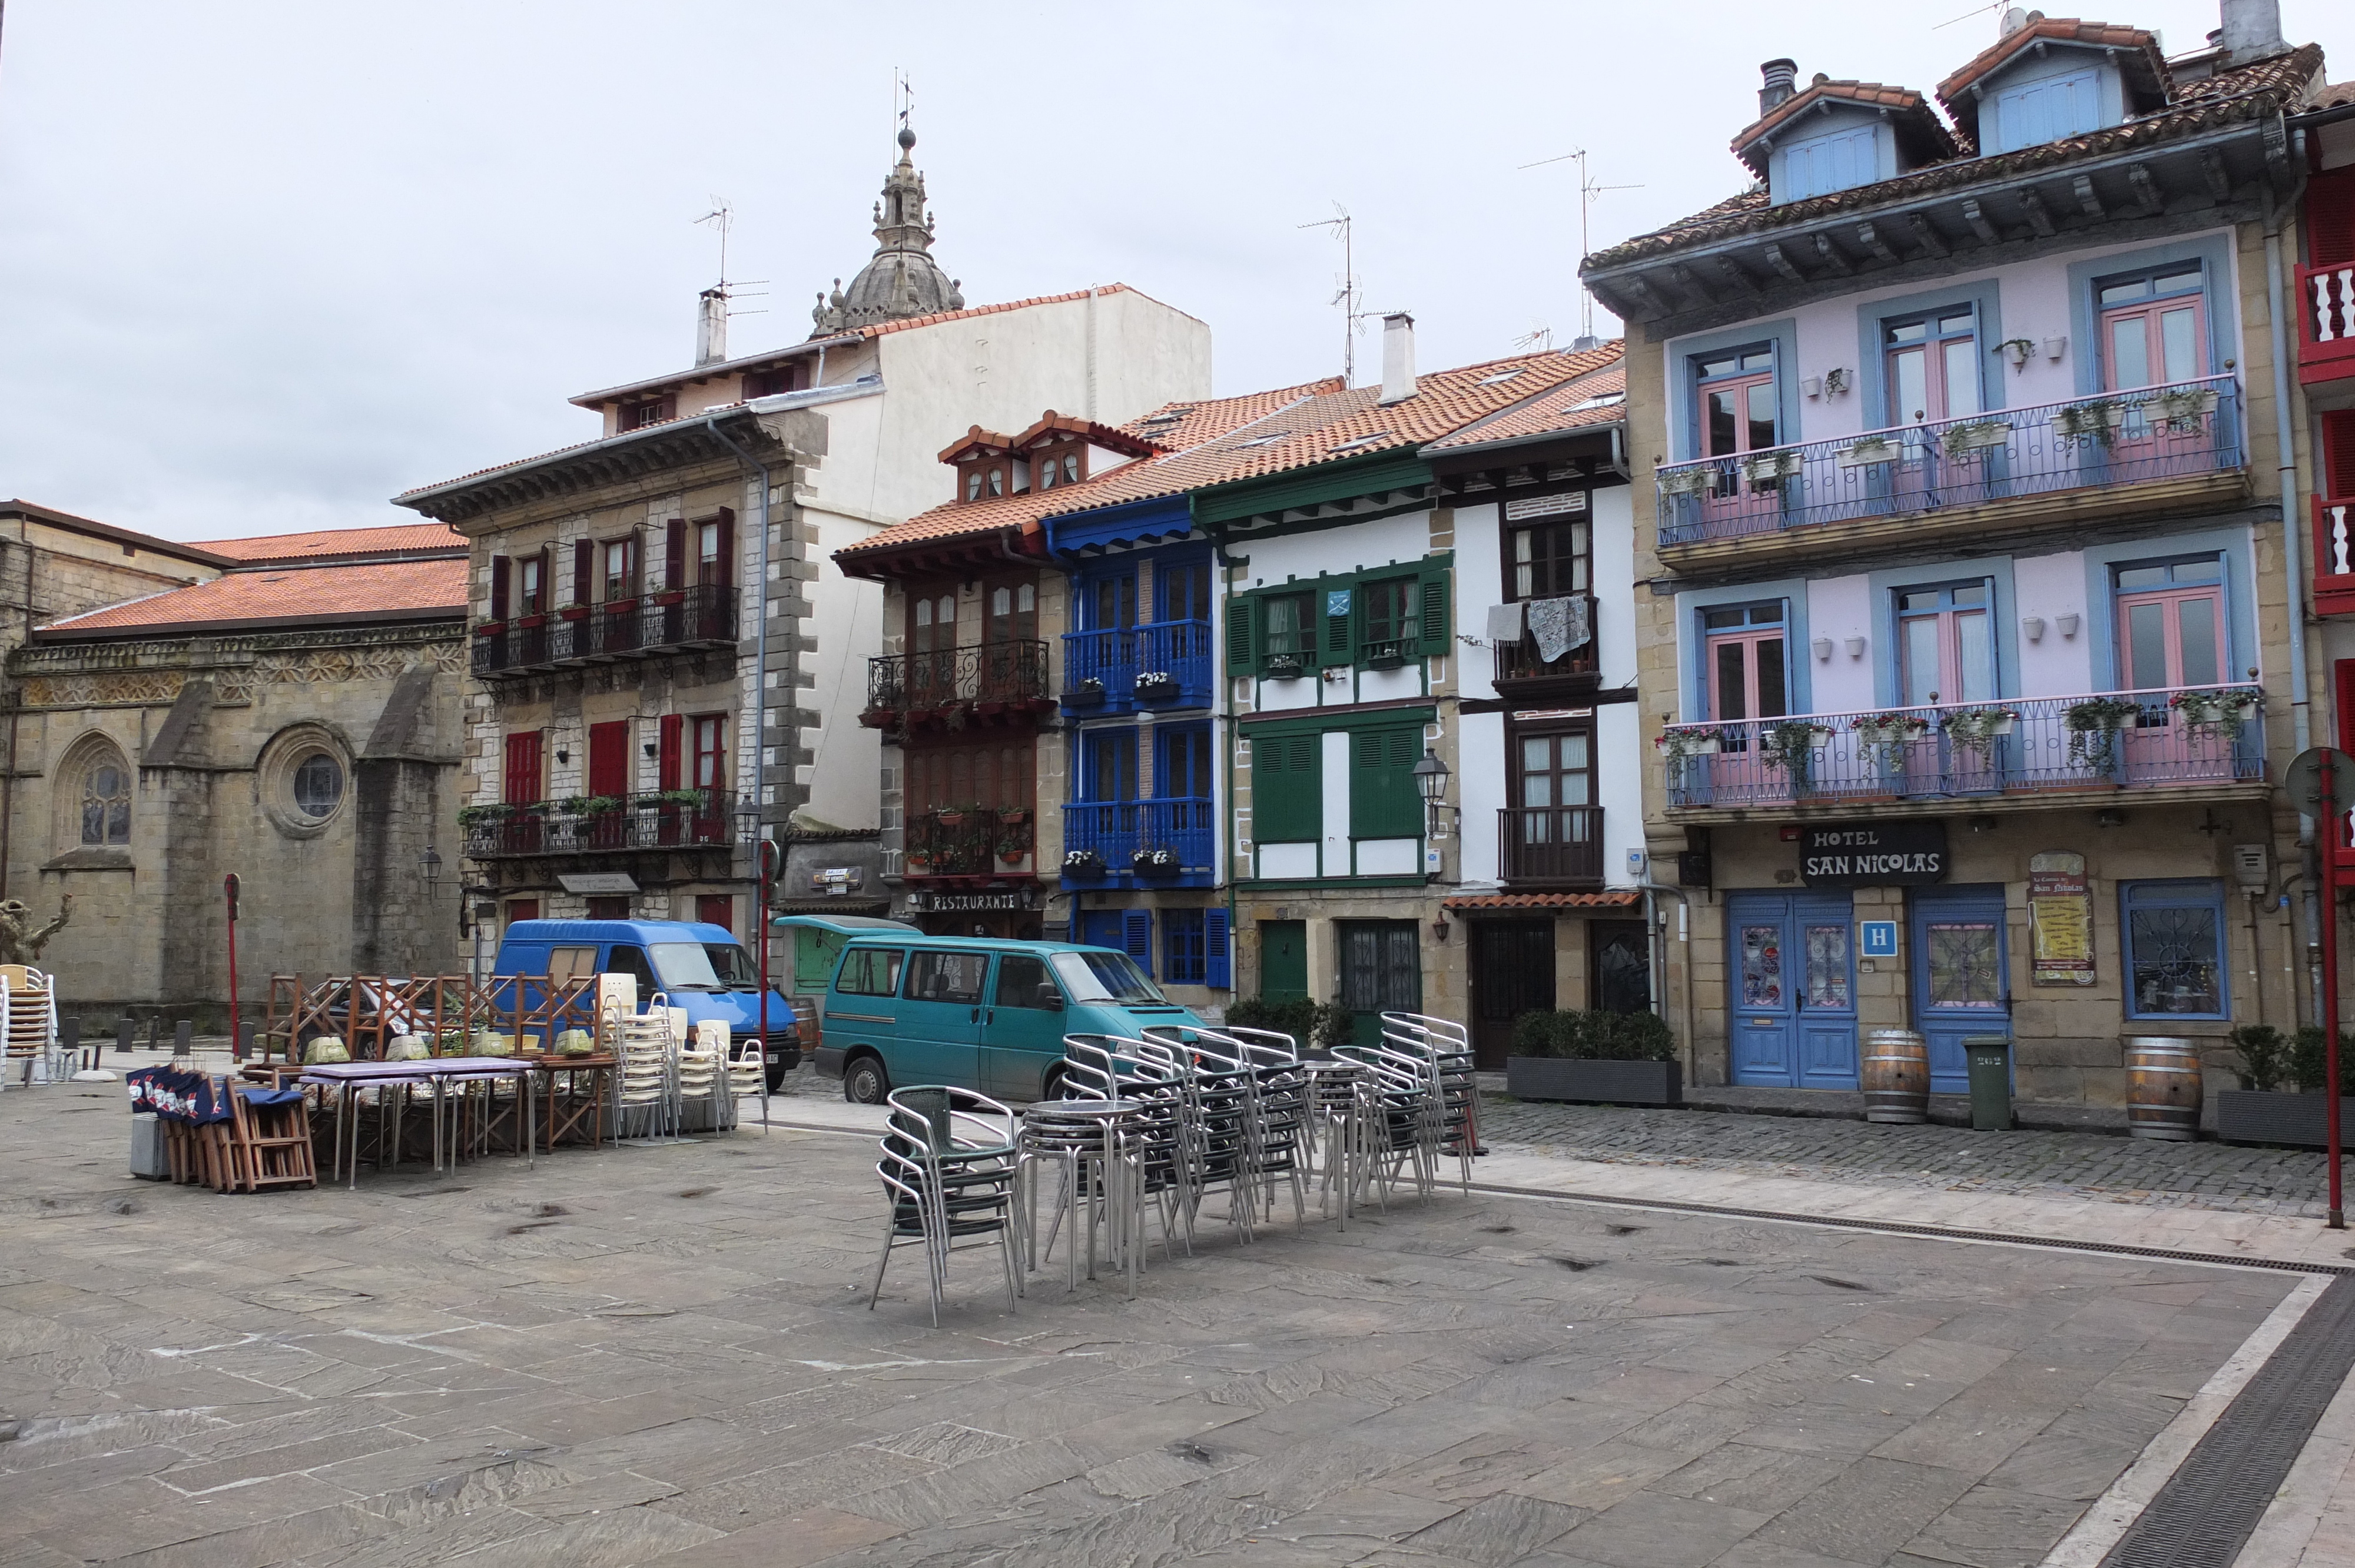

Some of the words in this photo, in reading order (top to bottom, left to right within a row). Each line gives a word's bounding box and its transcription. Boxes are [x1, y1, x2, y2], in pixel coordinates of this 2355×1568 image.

[1813, 831, 1878, 846] HOTEL
[1807, 856, 1849, 876] SAN
[934, 895, 1014, 910] RESTAURANTE
[1872, 928, 1886, 945] H
